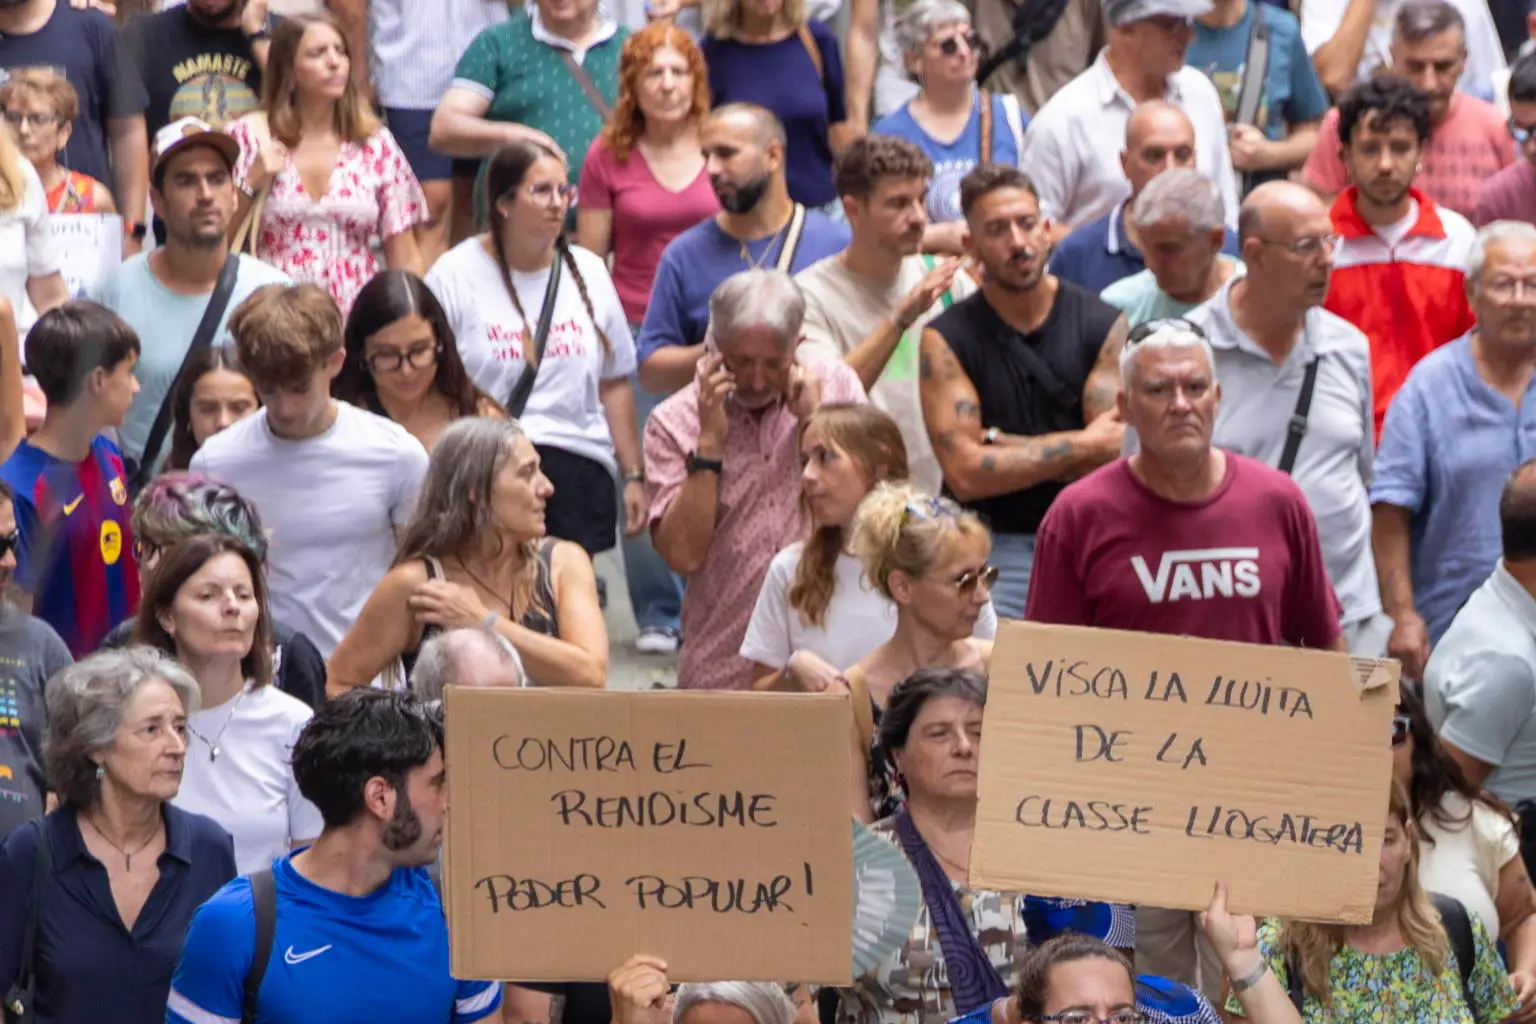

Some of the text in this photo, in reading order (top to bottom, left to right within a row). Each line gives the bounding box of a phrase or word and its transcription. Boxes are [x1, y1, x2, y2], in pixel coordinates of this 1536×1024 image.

[172, 53, 252, 84] NAMASTE
[1130, 547, 1261, 603] VANS
[1145, 670, 1188, 703] LA
[493, 735, 713, 774] CONTRA EL
[1073, 724, 1208, 770] DE LA
[1015, 795, 1364, 855] CLASSE LLOGATERA
[474, 861, 814, 927] PODER POPULAR!
